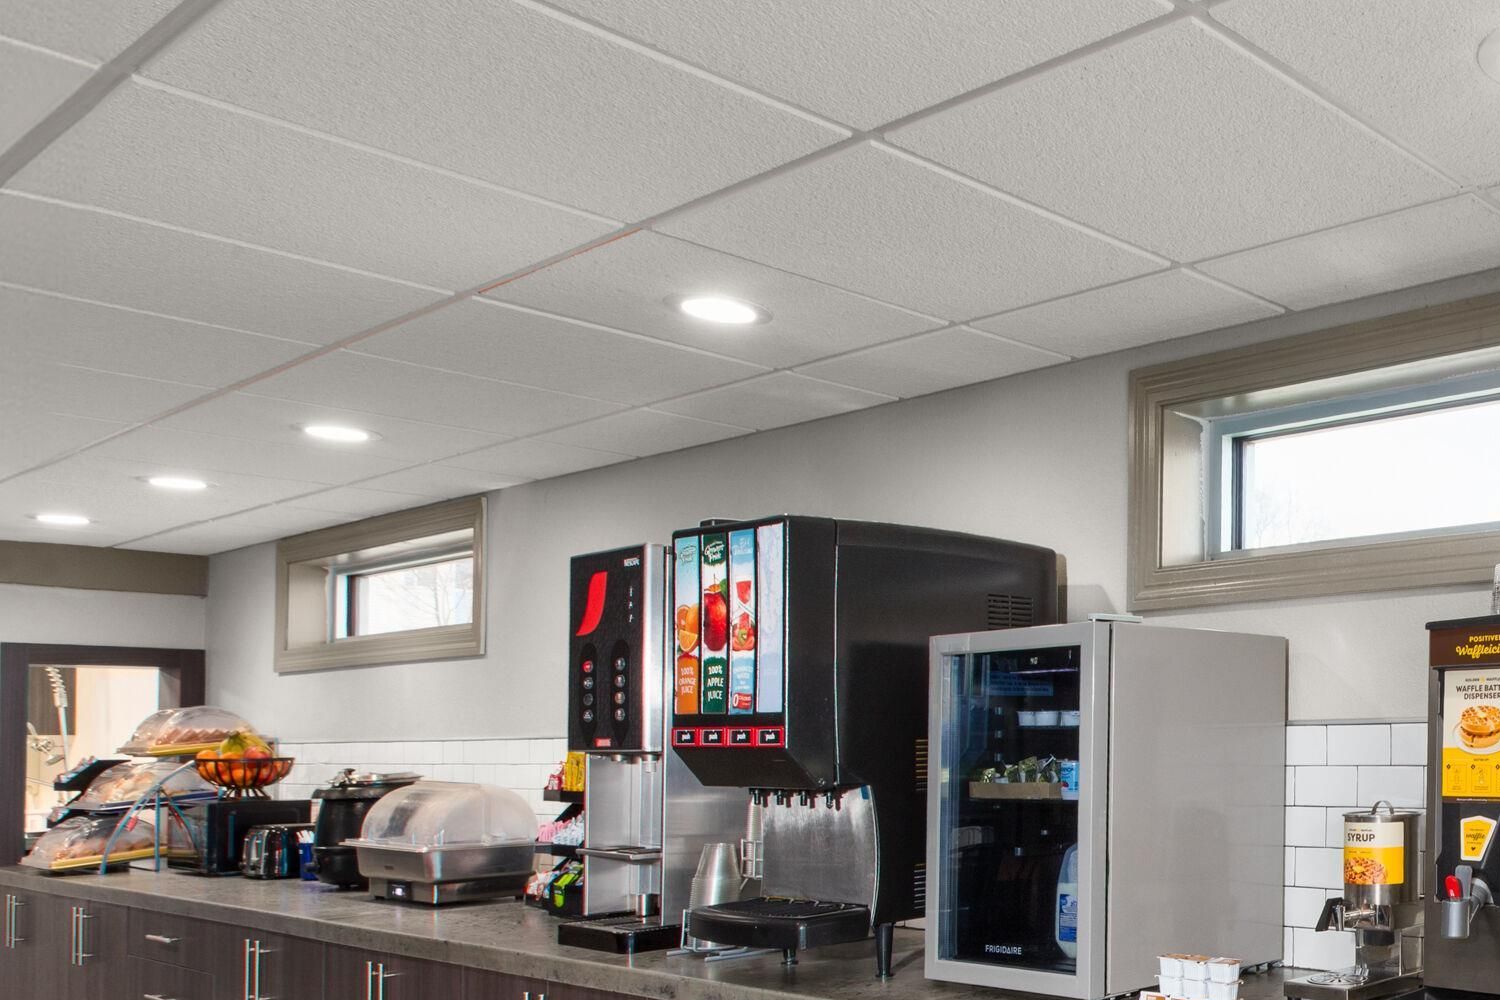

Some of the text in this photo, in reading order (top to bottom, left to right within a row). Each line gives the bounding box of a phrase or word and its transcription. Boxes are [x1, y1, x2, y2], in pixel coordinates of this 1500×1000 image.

[708, 665, 723, 675] 100%
[707, 678, 724, 687] APPLE
[707, 691, 723, 702] JUICE
[1347, 833, 1375, 842] SYRUP
[985, 944, 1022, 955] FRIGIDAIRE
